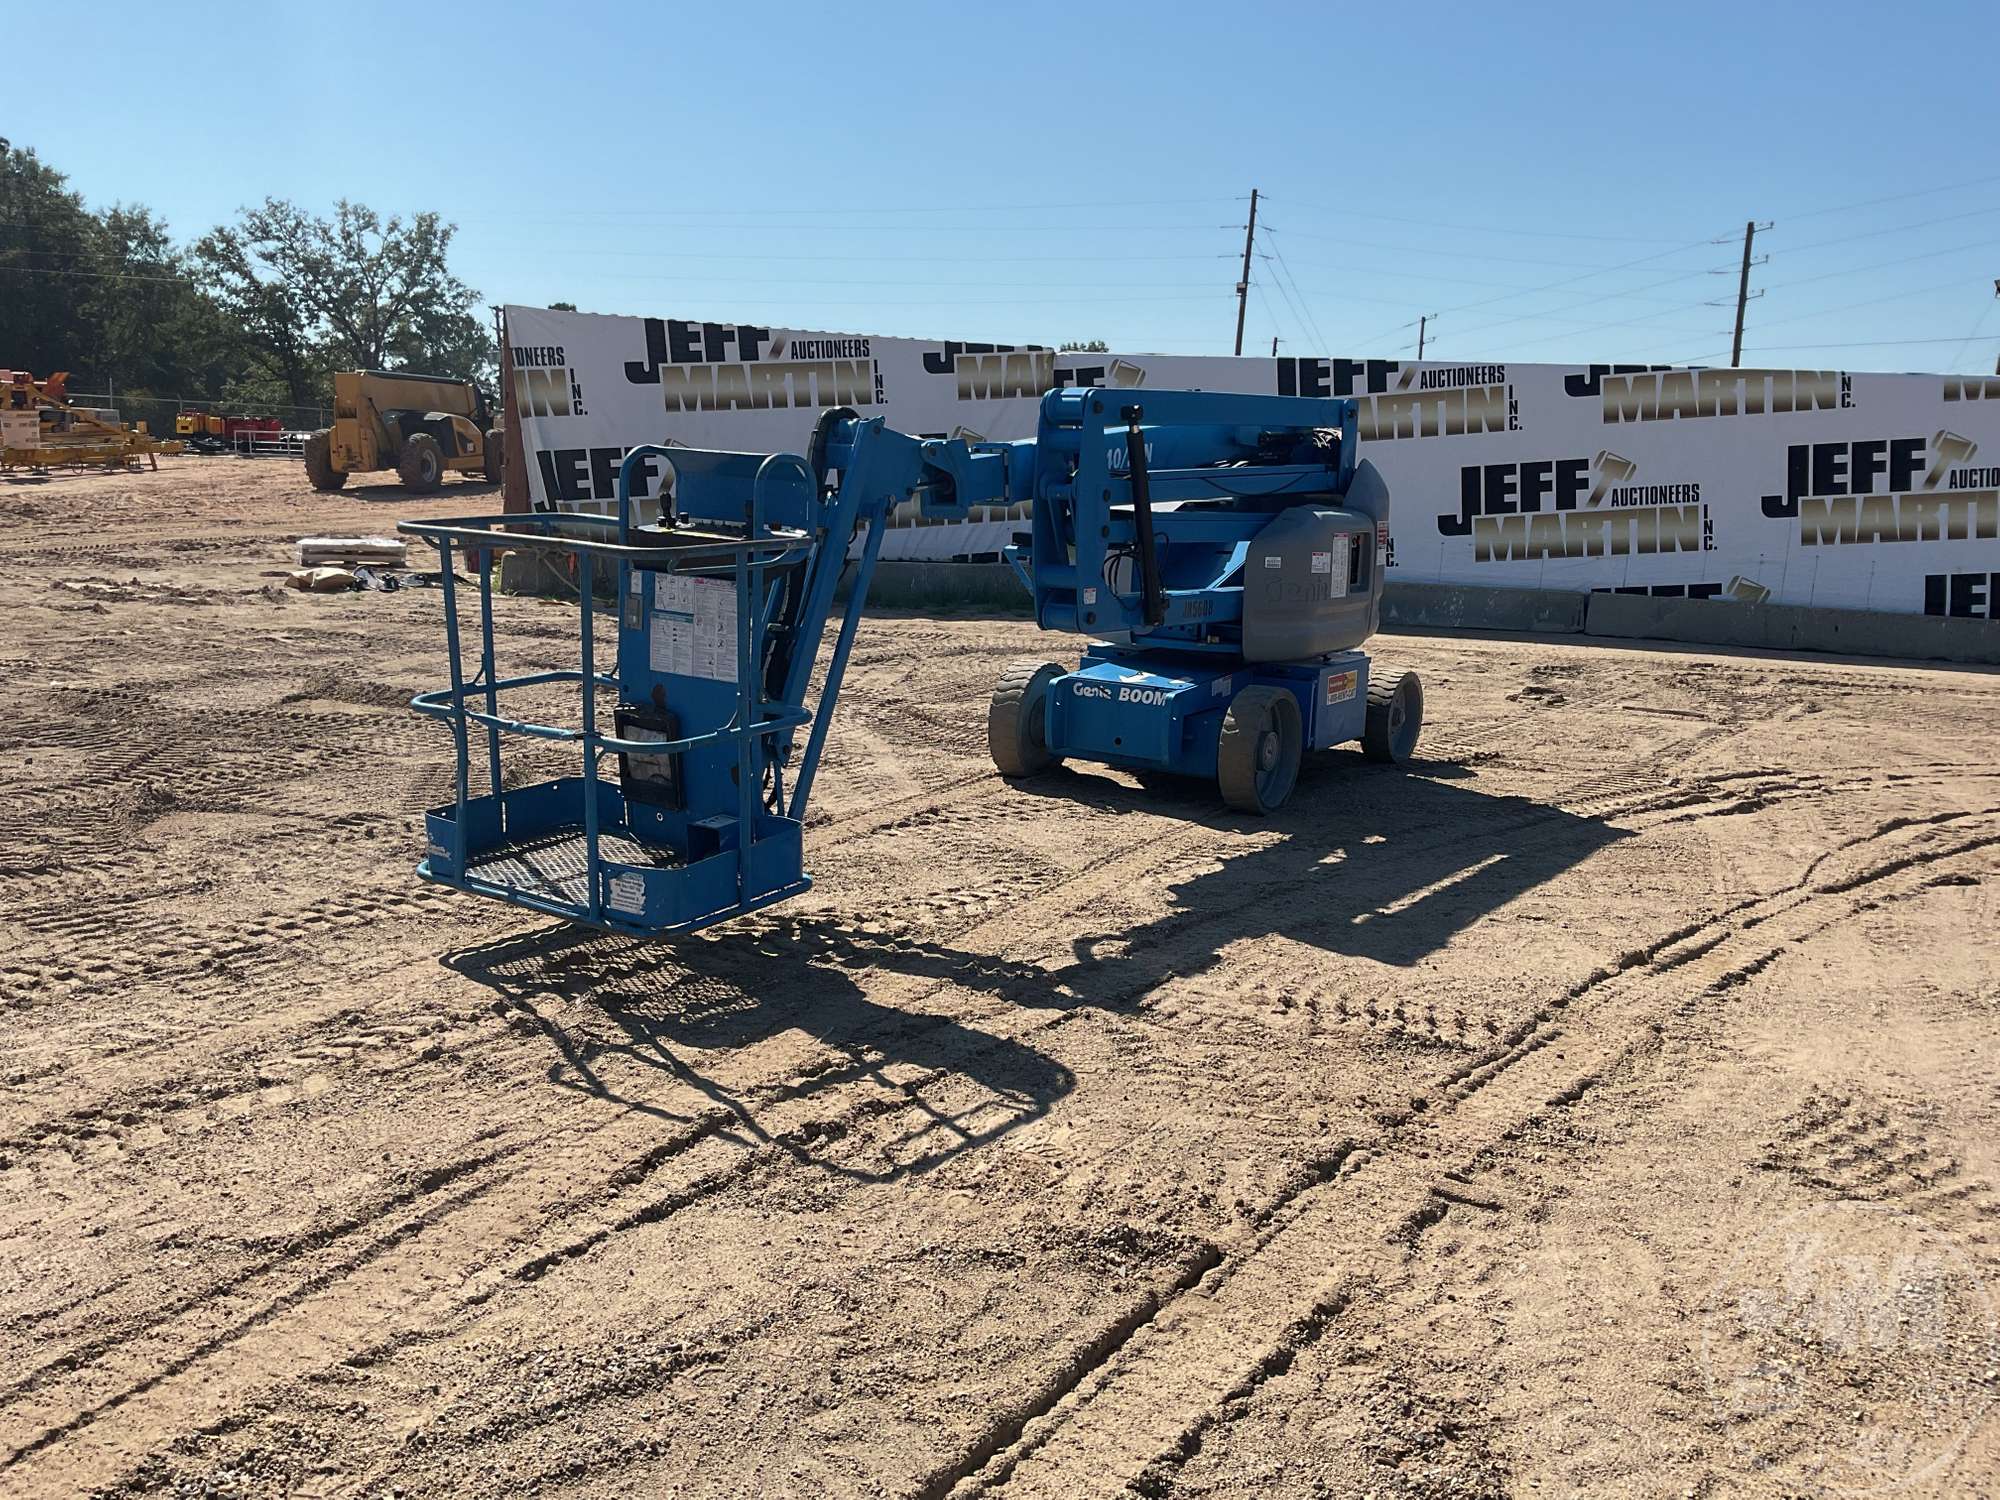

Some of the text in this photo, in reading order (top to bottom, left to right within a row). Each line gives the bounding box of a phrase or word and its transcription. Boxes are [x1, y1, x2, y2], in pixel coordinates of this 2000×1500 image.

[624, 317, 770, 384] JEFF
[791, 339, 870, 360] AUCTIONEERS
[661, 359, 873, 413] MARTIN
[1420, 365, 1505, 390] AUCTIONEERS
[1603, 369, 1837, 424] MARTIN
[1437, 458, 1590, 537] JEFF
[1611, 483, 1700, 507] AUCTIONEERS
[1760, 437, 1926, 519] JEFF
[1474, 505, 1699, 563] MARTIN
[1118, 686, 1168, 707] BOOM
